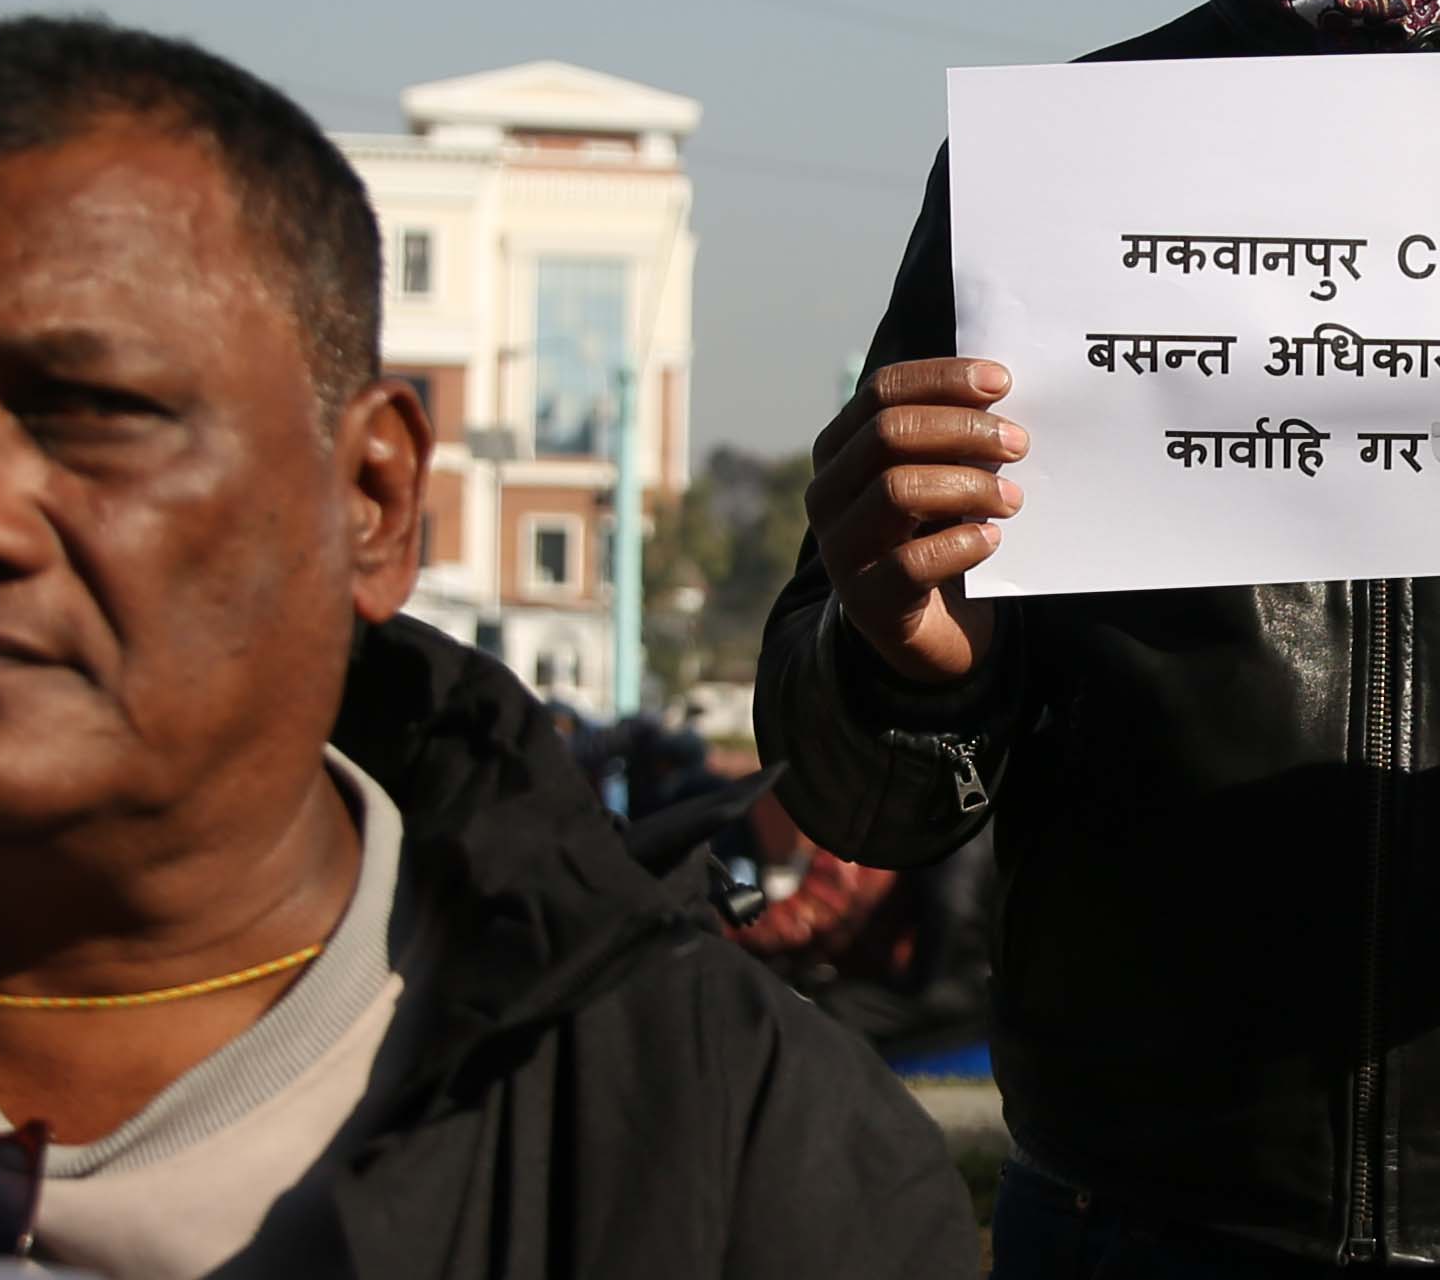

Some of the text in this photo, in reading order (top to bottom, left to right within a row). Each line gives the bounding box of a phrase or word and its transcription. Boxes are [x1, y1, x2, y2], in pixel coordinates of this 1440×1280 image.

[1120, 233, 1368, 301] मकवानपुर
[1085, 333, 1237, 377] बसन्त
[1164, 418, 1428, 477] कार्वाहि गर
